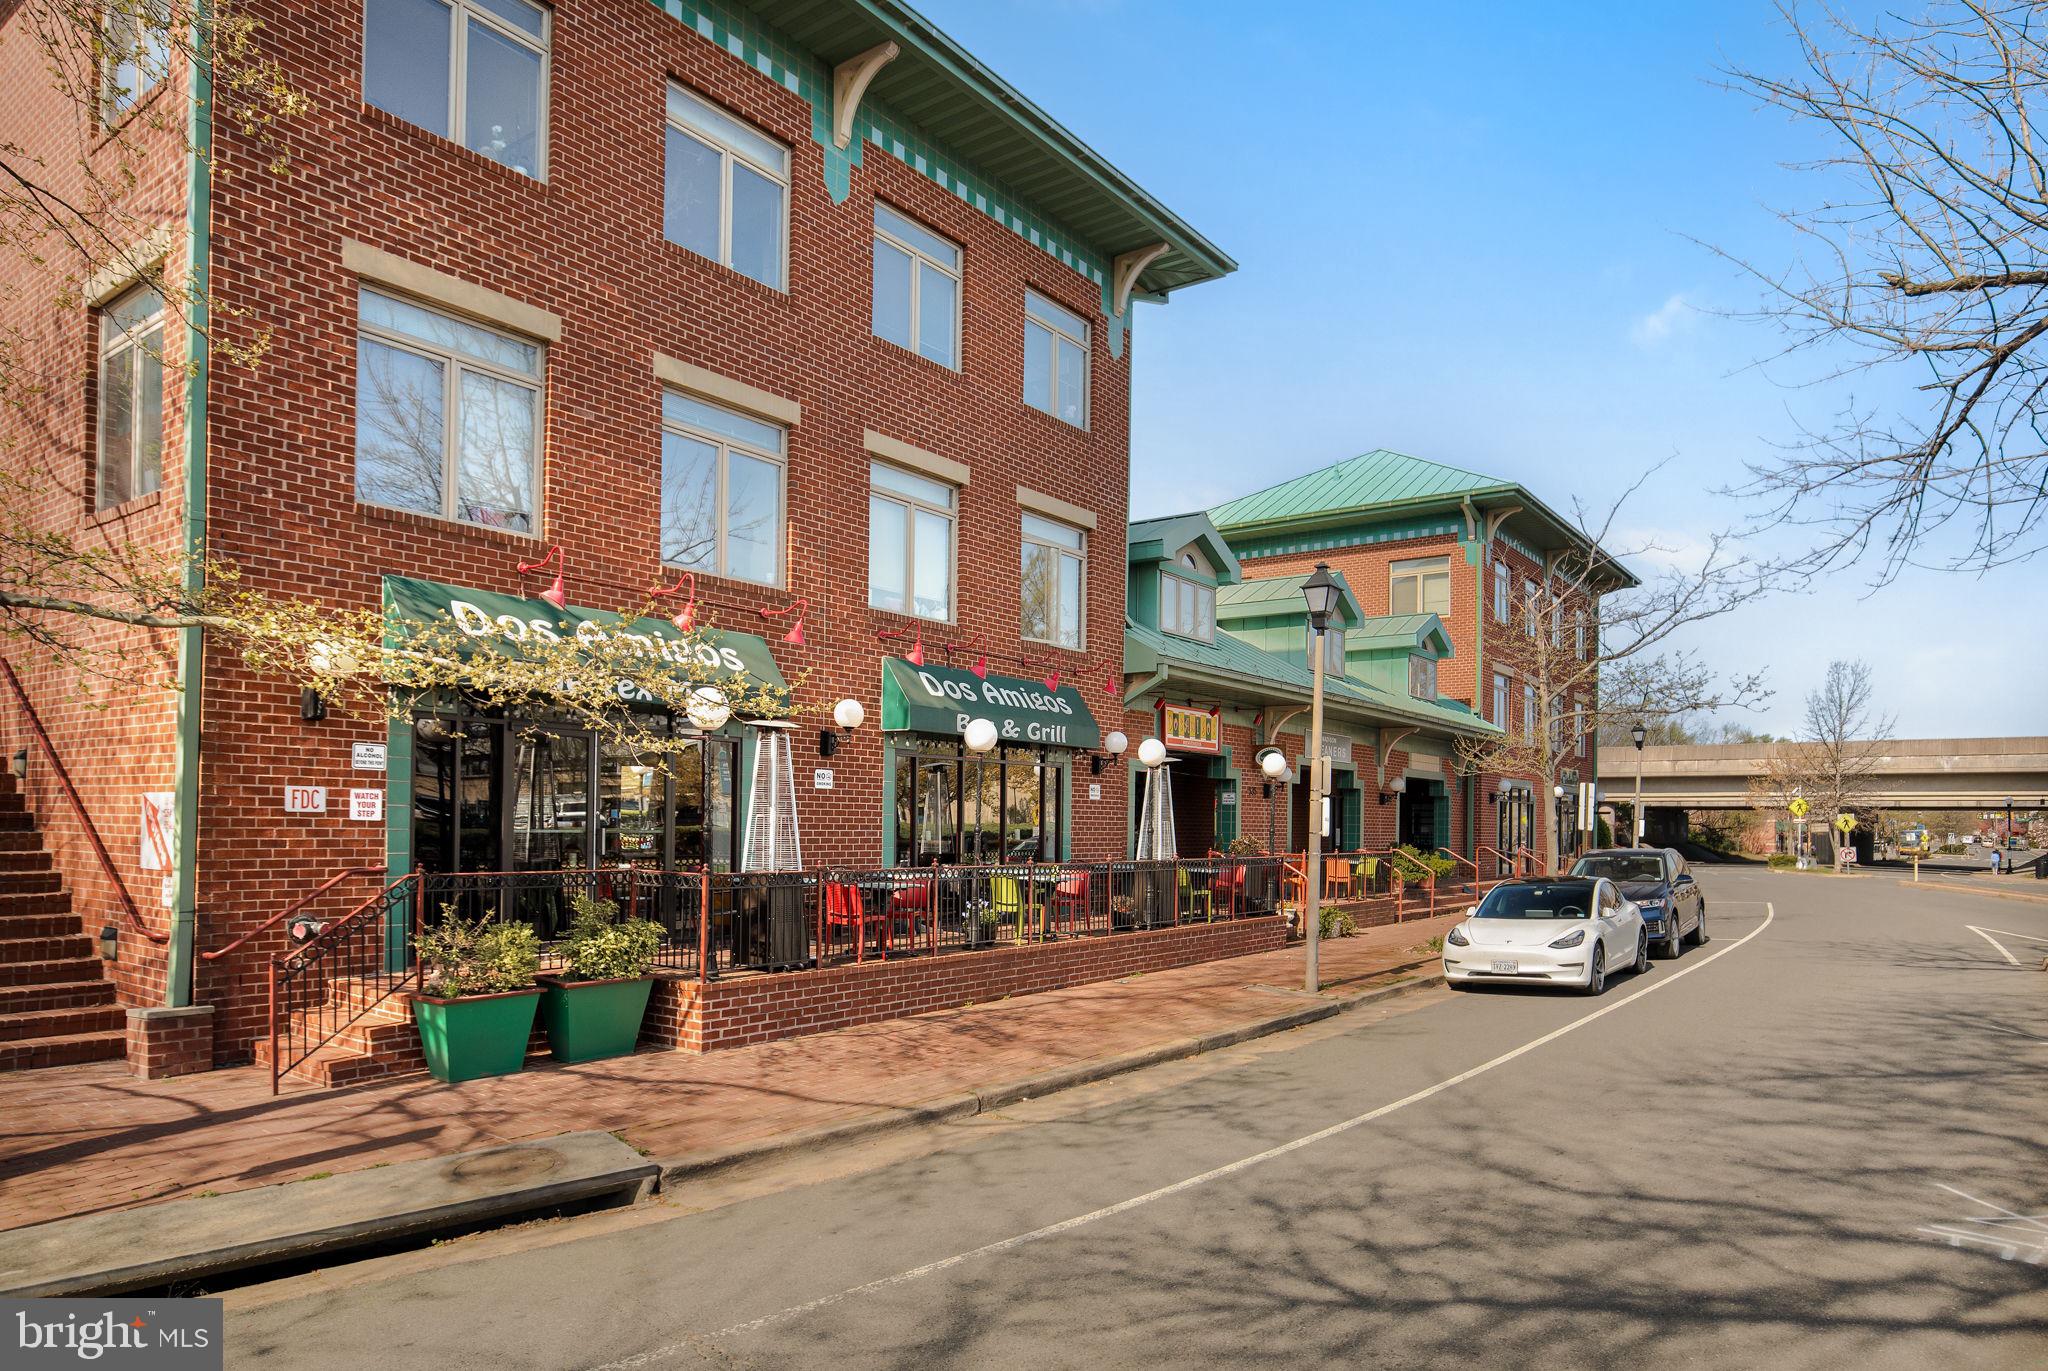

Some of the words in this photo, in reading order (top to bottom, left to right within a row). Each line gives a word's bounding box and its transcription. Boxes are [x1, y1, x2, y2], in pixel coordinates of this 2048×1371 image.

[450, 600, 561, 645] Dos
[918, 671, 978, 702] Dos
[982, 681, 1073, 715] Amigos
[1001, 719, 1021, 739] &
[1027, 722, 1066, 744] Grill
[1321, 744, 1346, 758] EANERS
[291, 789, 320, 809] FDC
[354, 792, 379, 800] WATCH
[356, 801, 376, 809] YOUR
[357, 810, 375, 818] STEP
